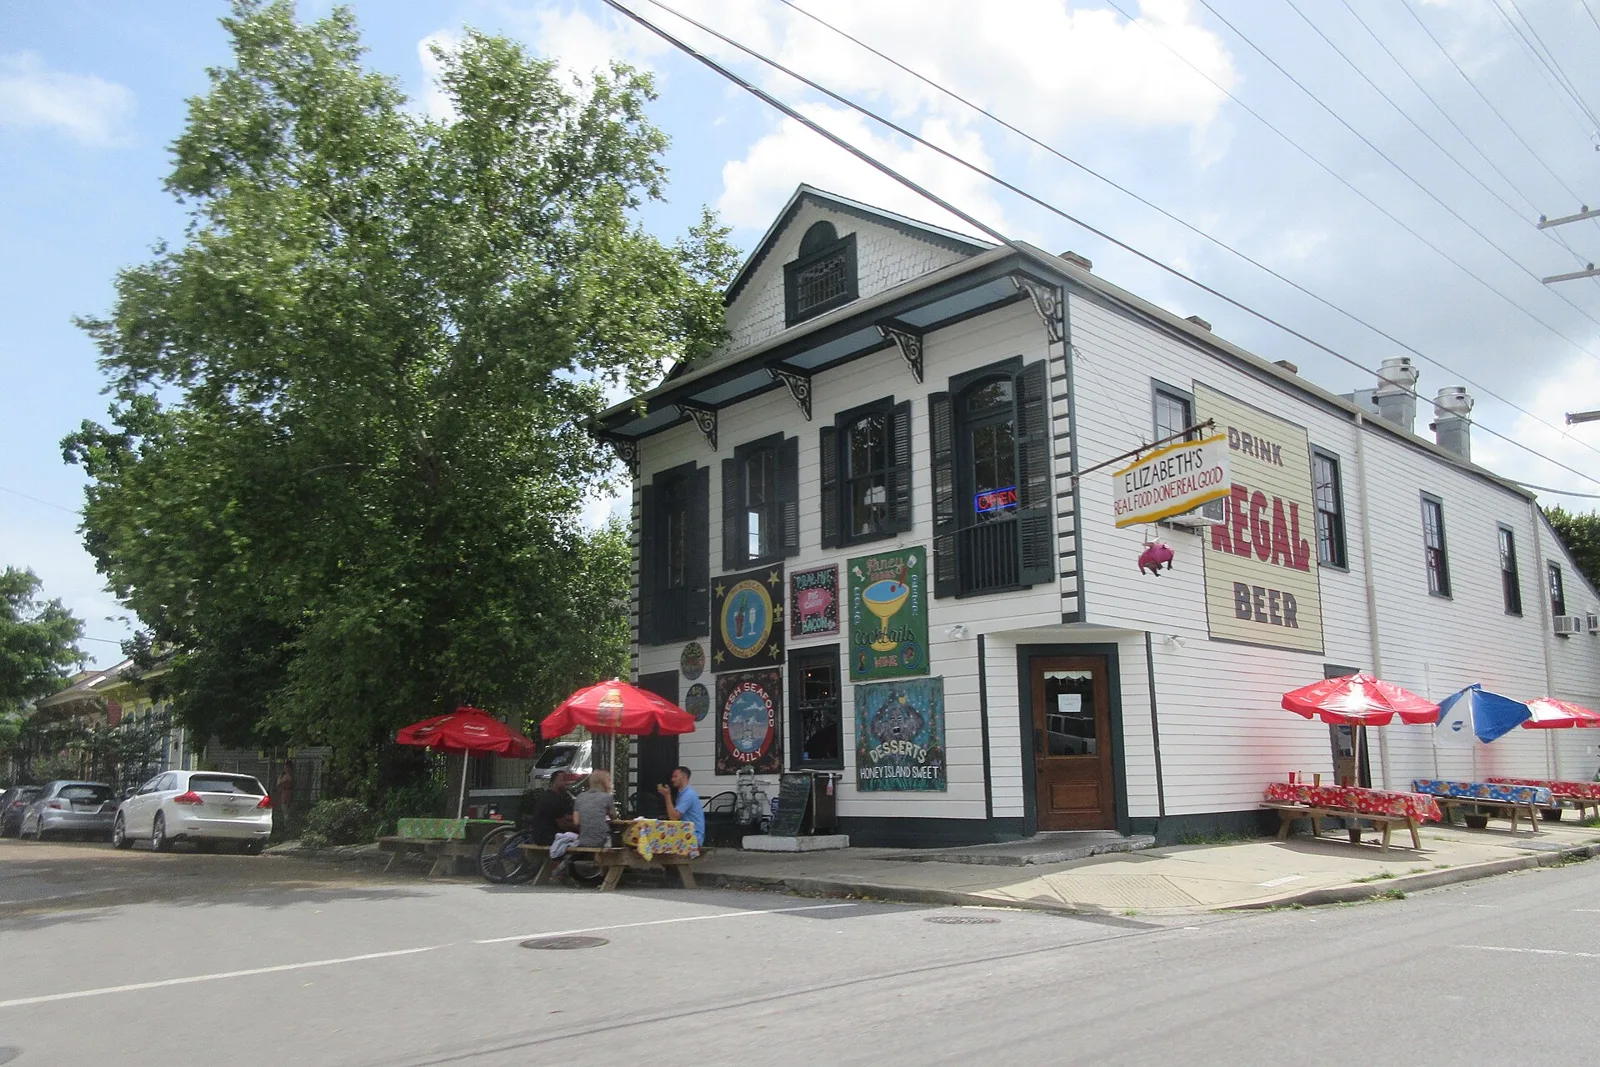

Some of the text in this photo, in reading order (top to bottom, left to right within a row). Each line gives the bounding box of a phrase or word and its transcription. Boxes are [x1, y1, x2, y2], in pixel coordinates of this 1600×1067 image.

[1227, 426, 1284, 468] DRINK
[1125, 447, 1204, 494] ELIZABETH'S
[978, 490, 1018, 510] OPEN
[1114, 466, 1224, 517] REAL FOOD DONE REAL GOOD
[1233, 581, 1299, 629] BEER
[801, 616, 829, 634] BACON
[722, 682, 775, 729] FRESH SEAFOOD
[732, 747, 762, 763] DAILY
[869, 739, 928, 764] DESSERTS
[860, 765, 939, 780] HONEY ISLAND SWEET
